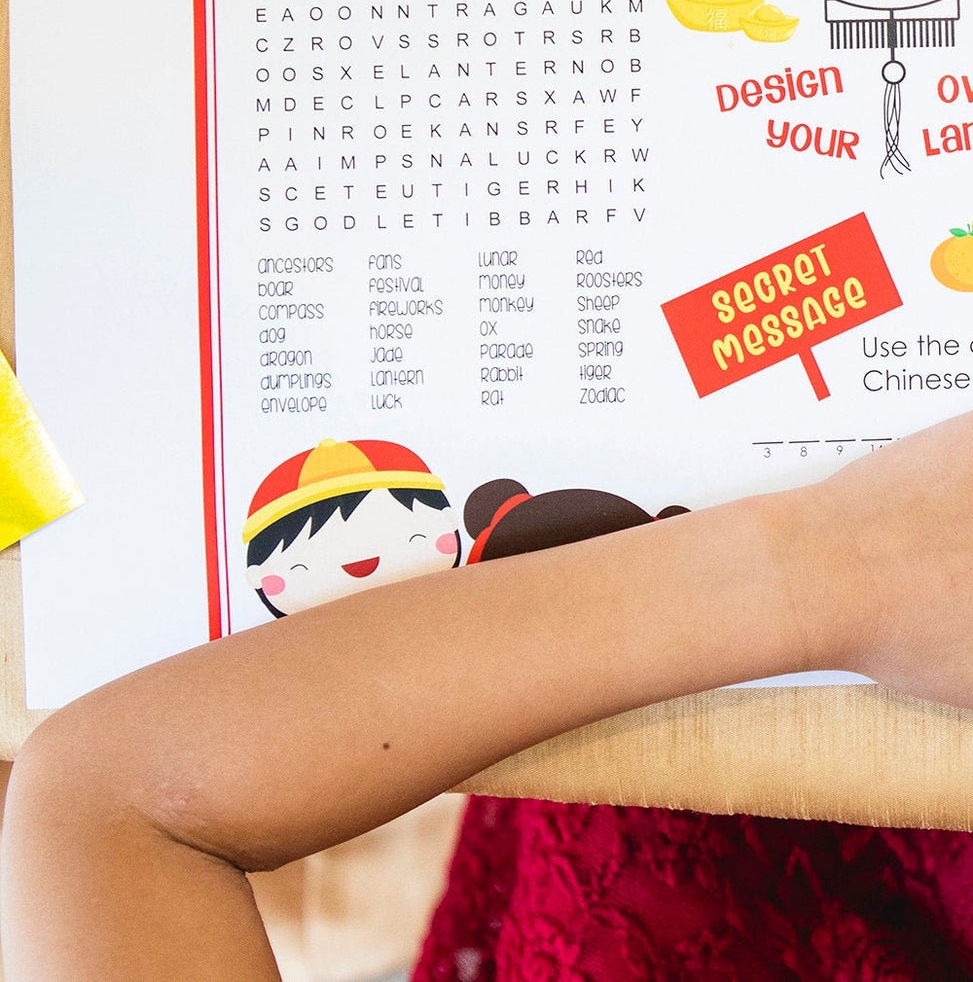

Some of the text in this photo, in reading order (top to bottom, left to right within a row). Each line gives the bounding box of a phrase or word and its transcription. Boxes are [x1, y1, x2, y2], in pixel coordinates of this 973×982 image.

[863, 337, 907, 358] Use
[917, 335, 959, 356] the
[863, 369, 970, 392] Chinese
[764, 447, 771, 459] 3
[800, 446, 807, 457] 8
[836, 445, 843, 456] 9
